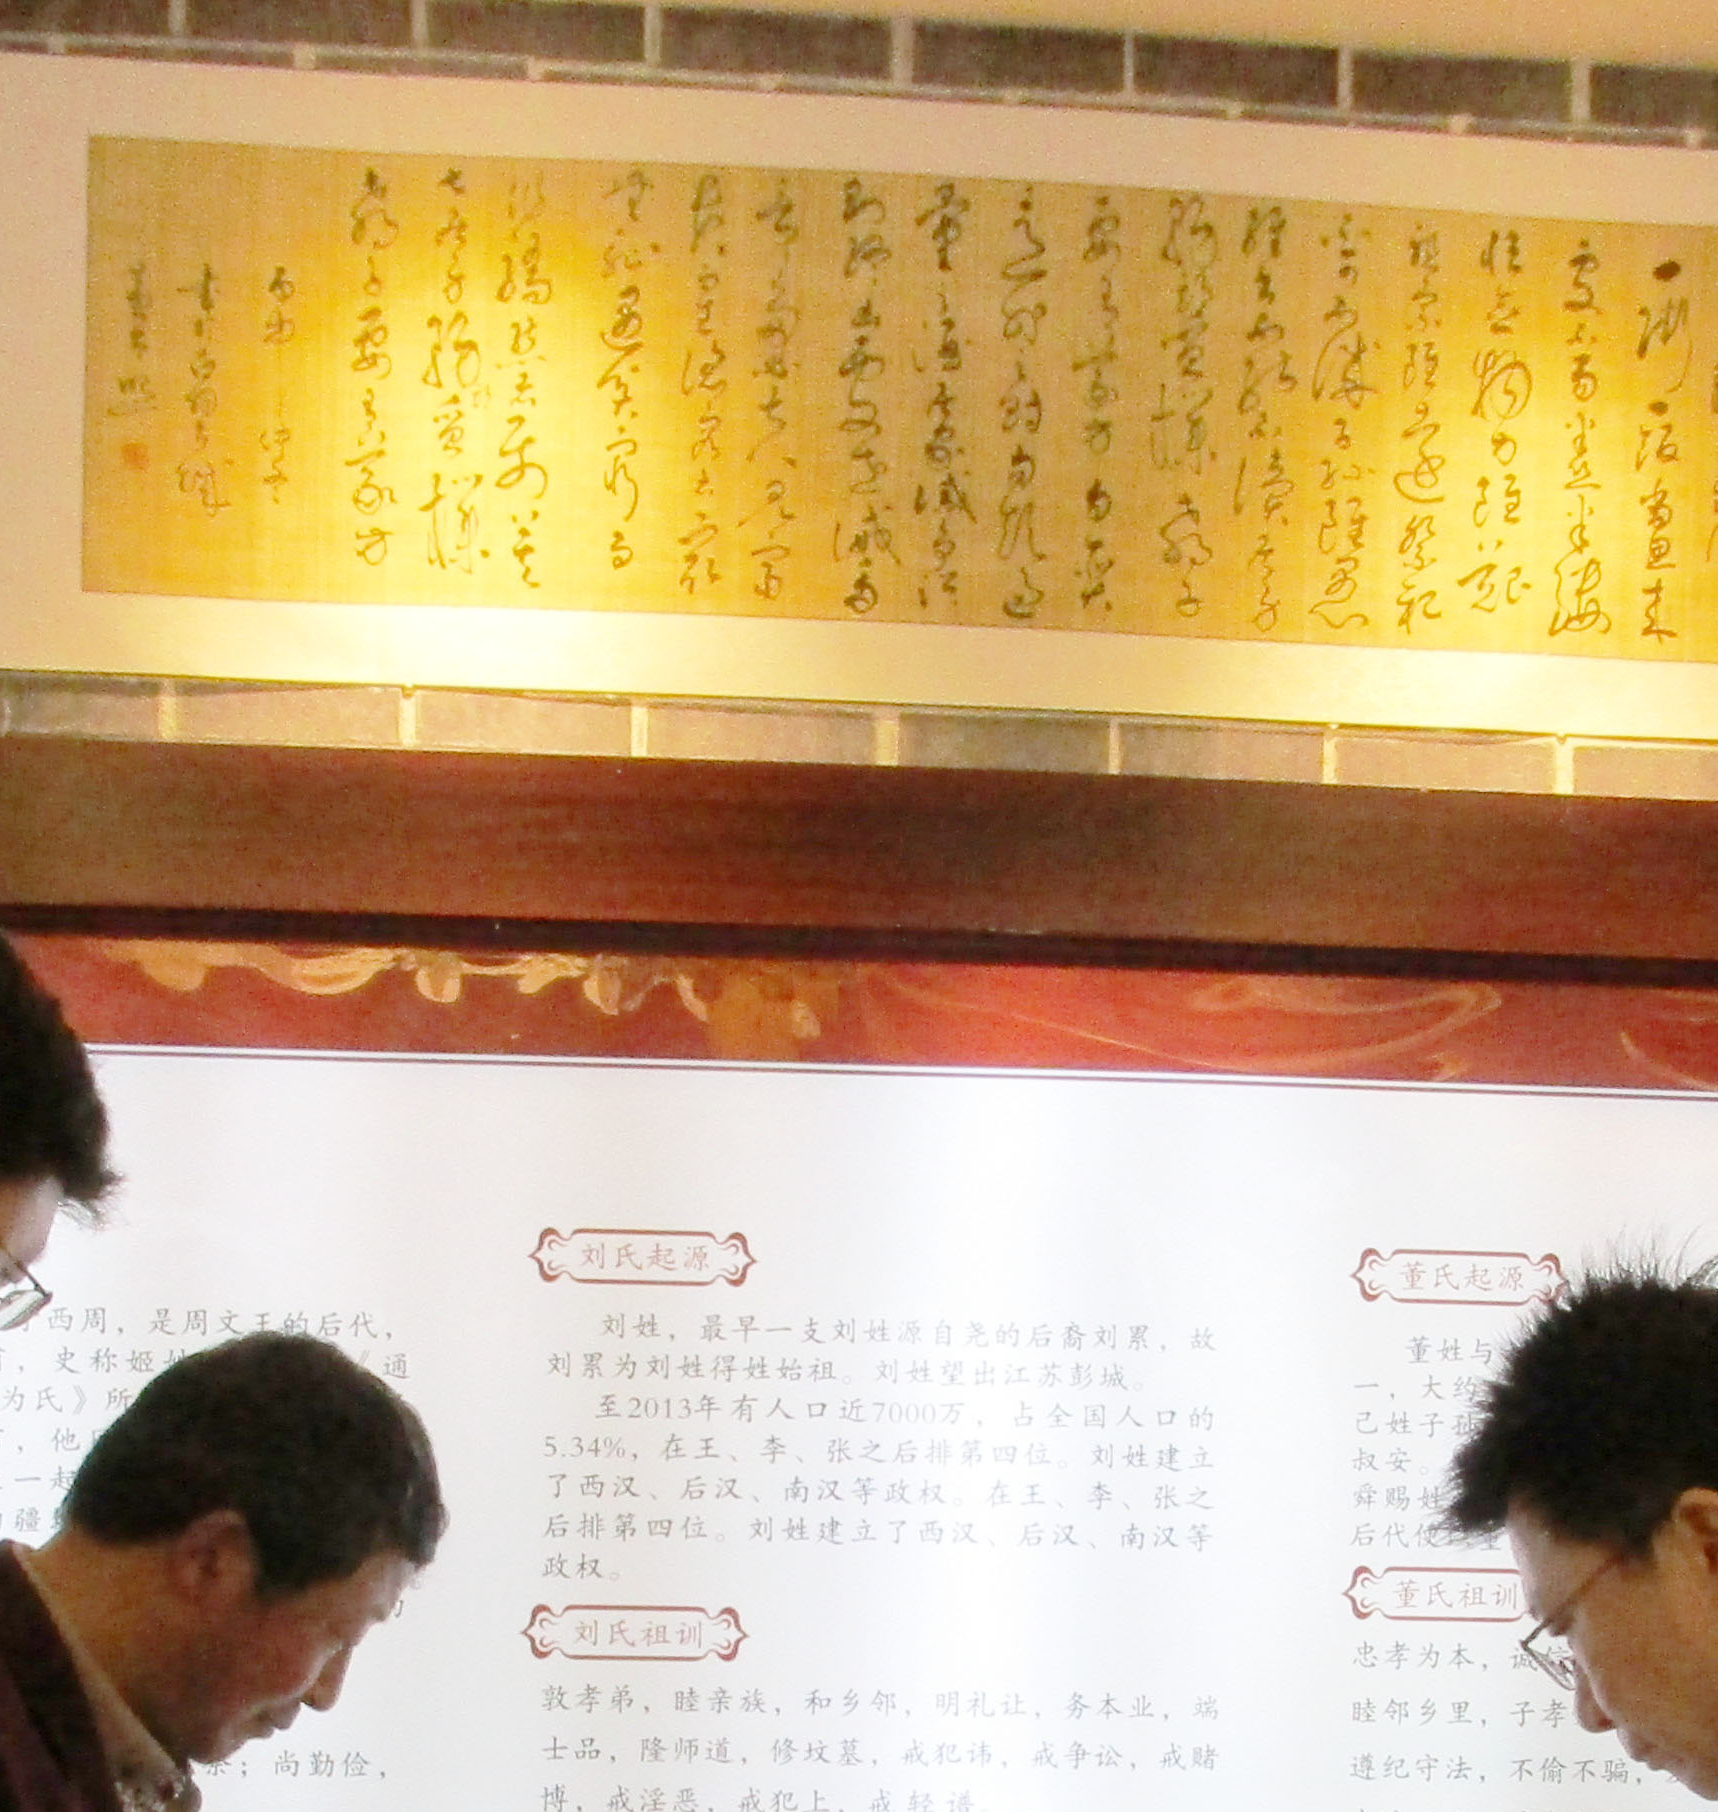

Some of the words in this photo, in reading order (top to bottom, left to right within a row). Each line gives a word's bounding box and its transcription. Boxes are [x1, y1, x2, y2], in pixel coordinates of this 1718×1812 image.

[581, 1242, 711, 1273] 刘氏起源
[1399, 1259, 1525, 1293] 董氏起源
[1405, 1335, 1494, 1365] 董姓与
[547, 1352, 1144, 1392] 刘累为刘姓得姓始祖。刘姓望出江苏彭城。
[594, 1394, 1215, 1431] 至2013年有人口近7000万，占全国人口的
[543, 1432, 1215, 1472] 5.34%，在王、李、张之后排第四位。刘姓建立
[1351, 1447, 1429, 1477] 叔安。
[546, 1473, 1215, 1511] 了西汉、后汉、南汉等政权。在王、李、张之
[543, 1512, 1213, 1552] 后排第四位。刘姓建立了西汉、后汉、南汉等
[542, 1552, 621, 1582] 政权。
[1391, 1578, 1519, 1610] 董氏祖训
[574, 1619, 704, 1650] 刘氏祖训
[1351, 1697, 1569, 1728] 睦邻乡里，子孝
[1349, 1754, 1681, 1786] 遵纪守法，不偷不骗，
